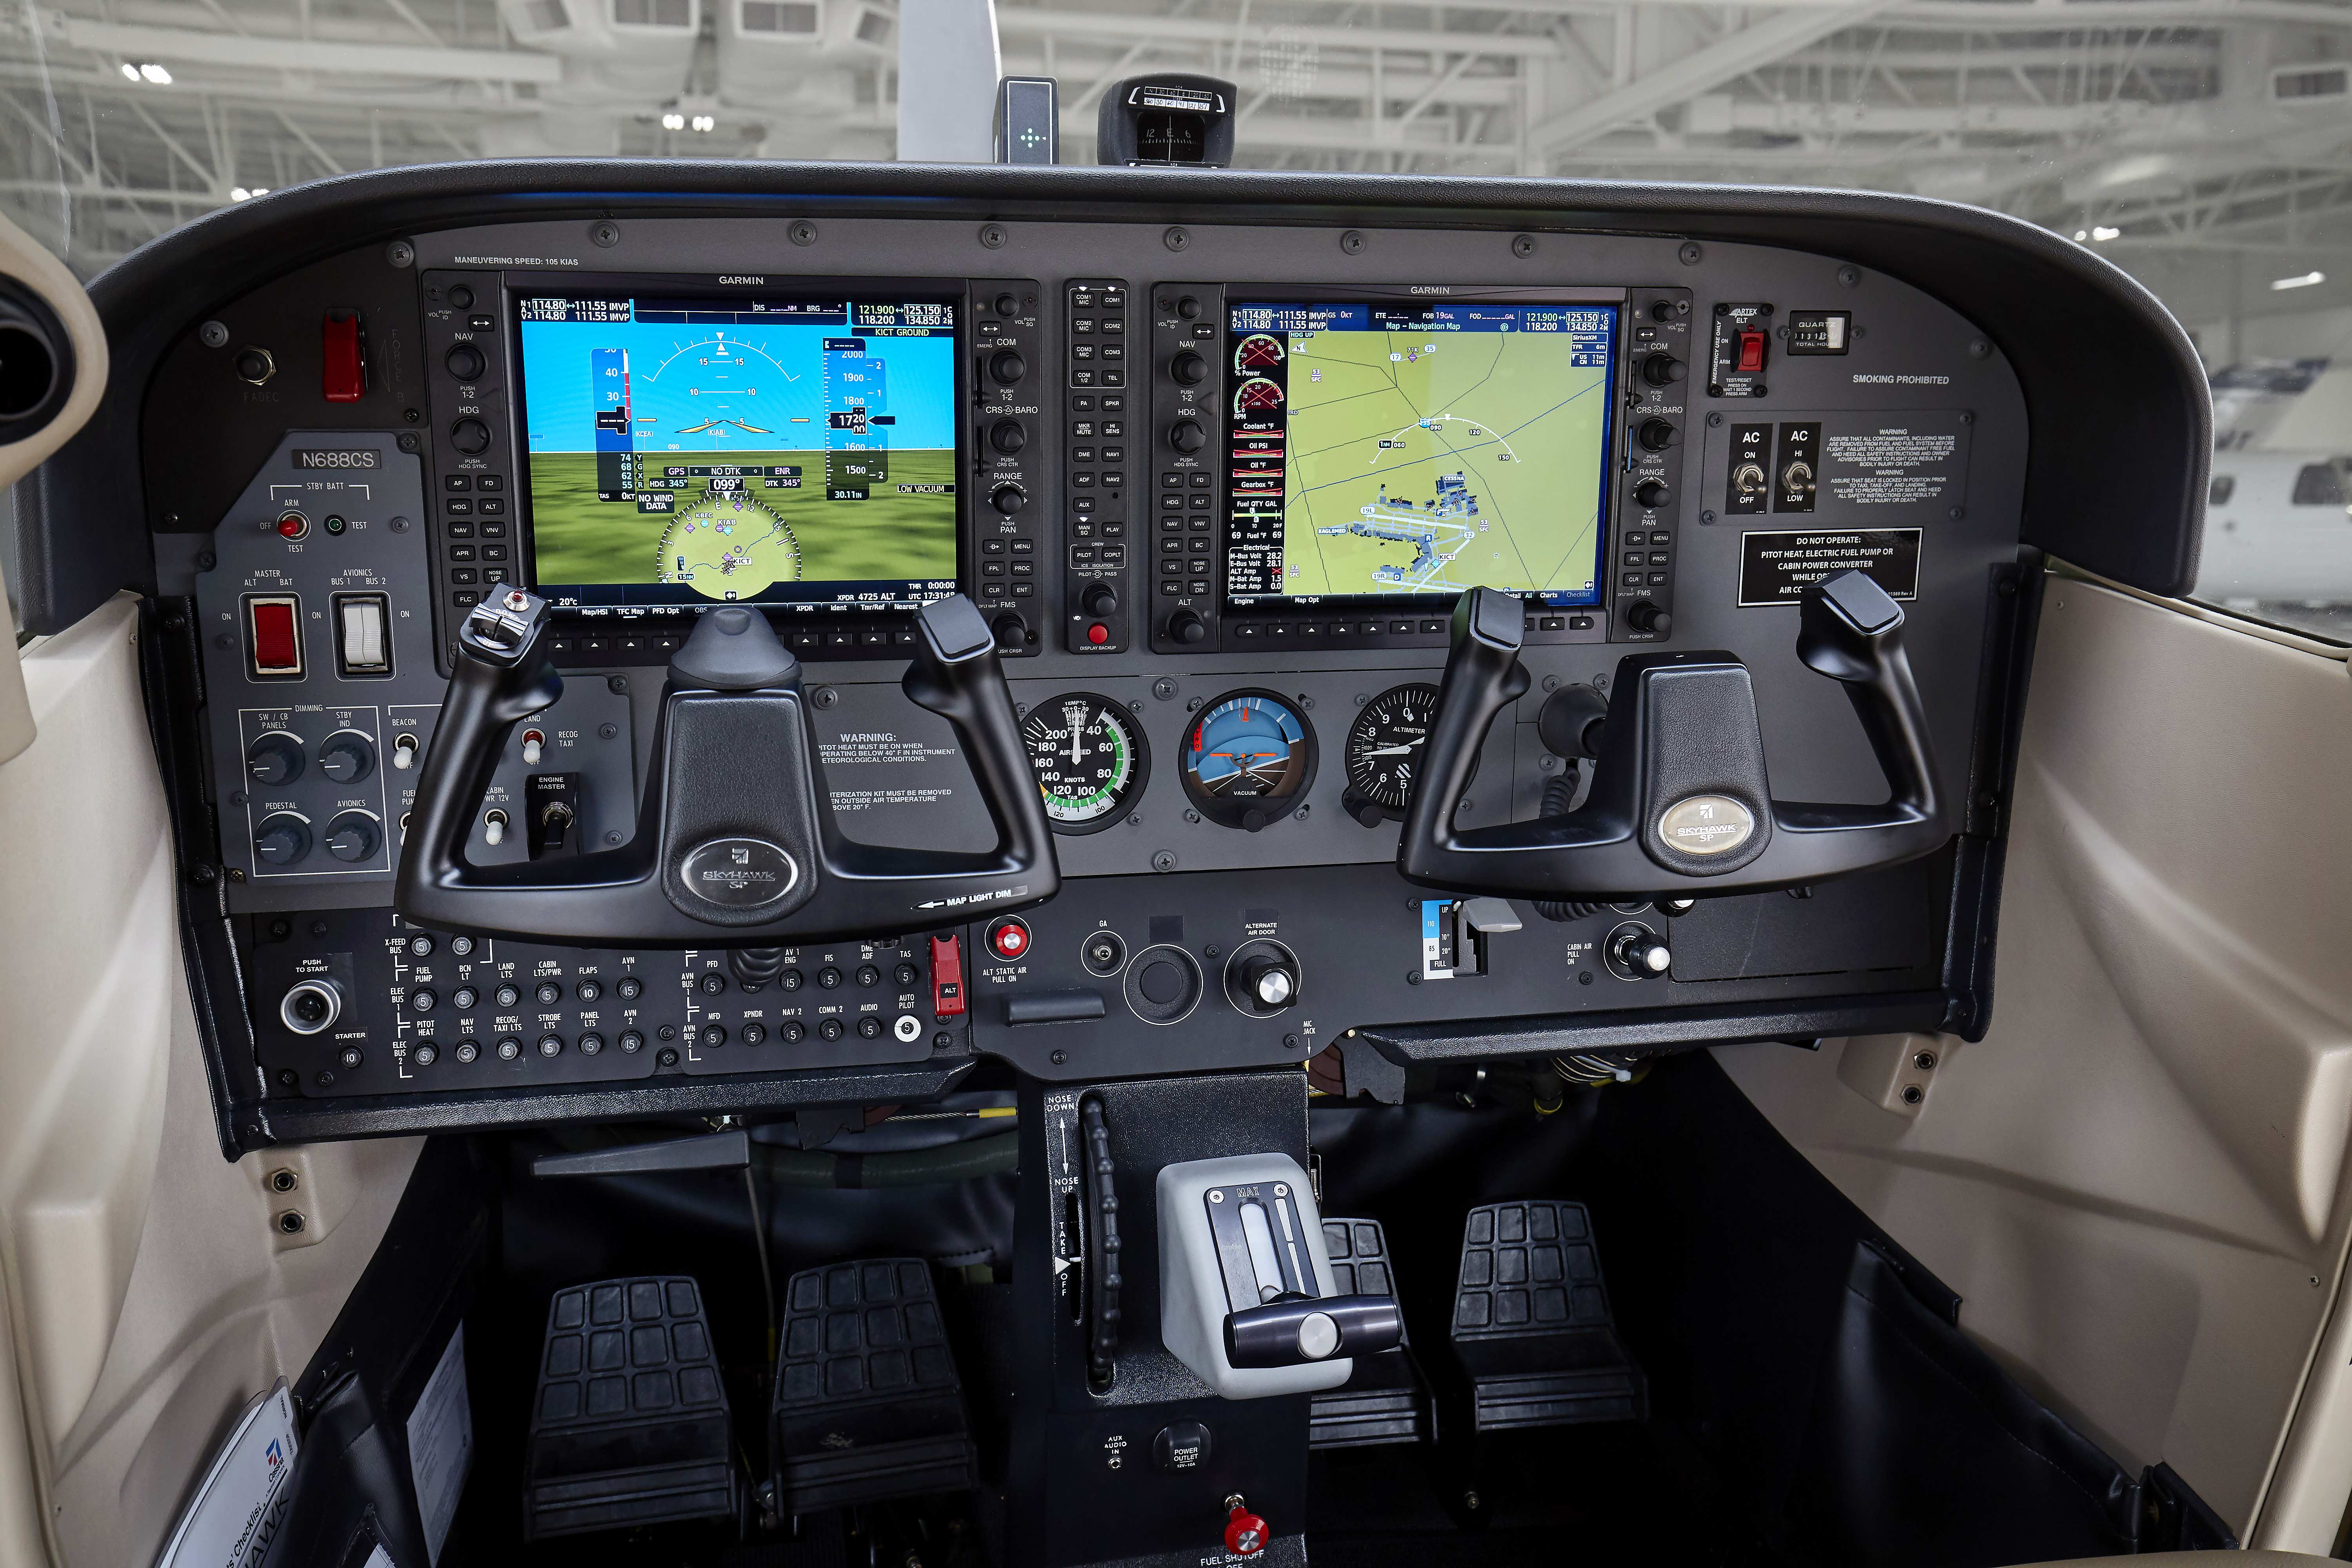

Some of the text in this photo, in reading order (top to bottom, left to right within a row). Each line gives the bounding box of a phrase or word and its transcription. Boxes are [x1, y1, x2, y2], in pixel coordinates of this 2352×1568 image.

[1147, 129, 1154, 137] 12
[859, 305, 941, 315] 121.900 125.150
[534, 311, 630, 321] 114.80 111.55 IMVP
[1387, 322, 1460, 331] Map Navigation Map
[1853, 375, 1949, 384] SMOKING PROHIBITED
[1742, 432, 1760, 443] AC
[303, 453, 374, 467] N688CS
[714, 479, 740, 490] 099°
[840, 733, 896, 742] WARNING:
[1677, 824, 1737, 834] SKYHAWK
[947, 889, 1011, 906] MAP LIGHT DIM
[534, 968, 561, 976] LTS/PWR
[1049, 1094, 1072, 1103] NOSE
[1047, 1102, 1074, 1112] DOWN
[1237, 1187, 1259, 1197] MAX
[269, 1457, 284, 1483] Cessna
[1201, 1557, 1222, 1566] FUEL
